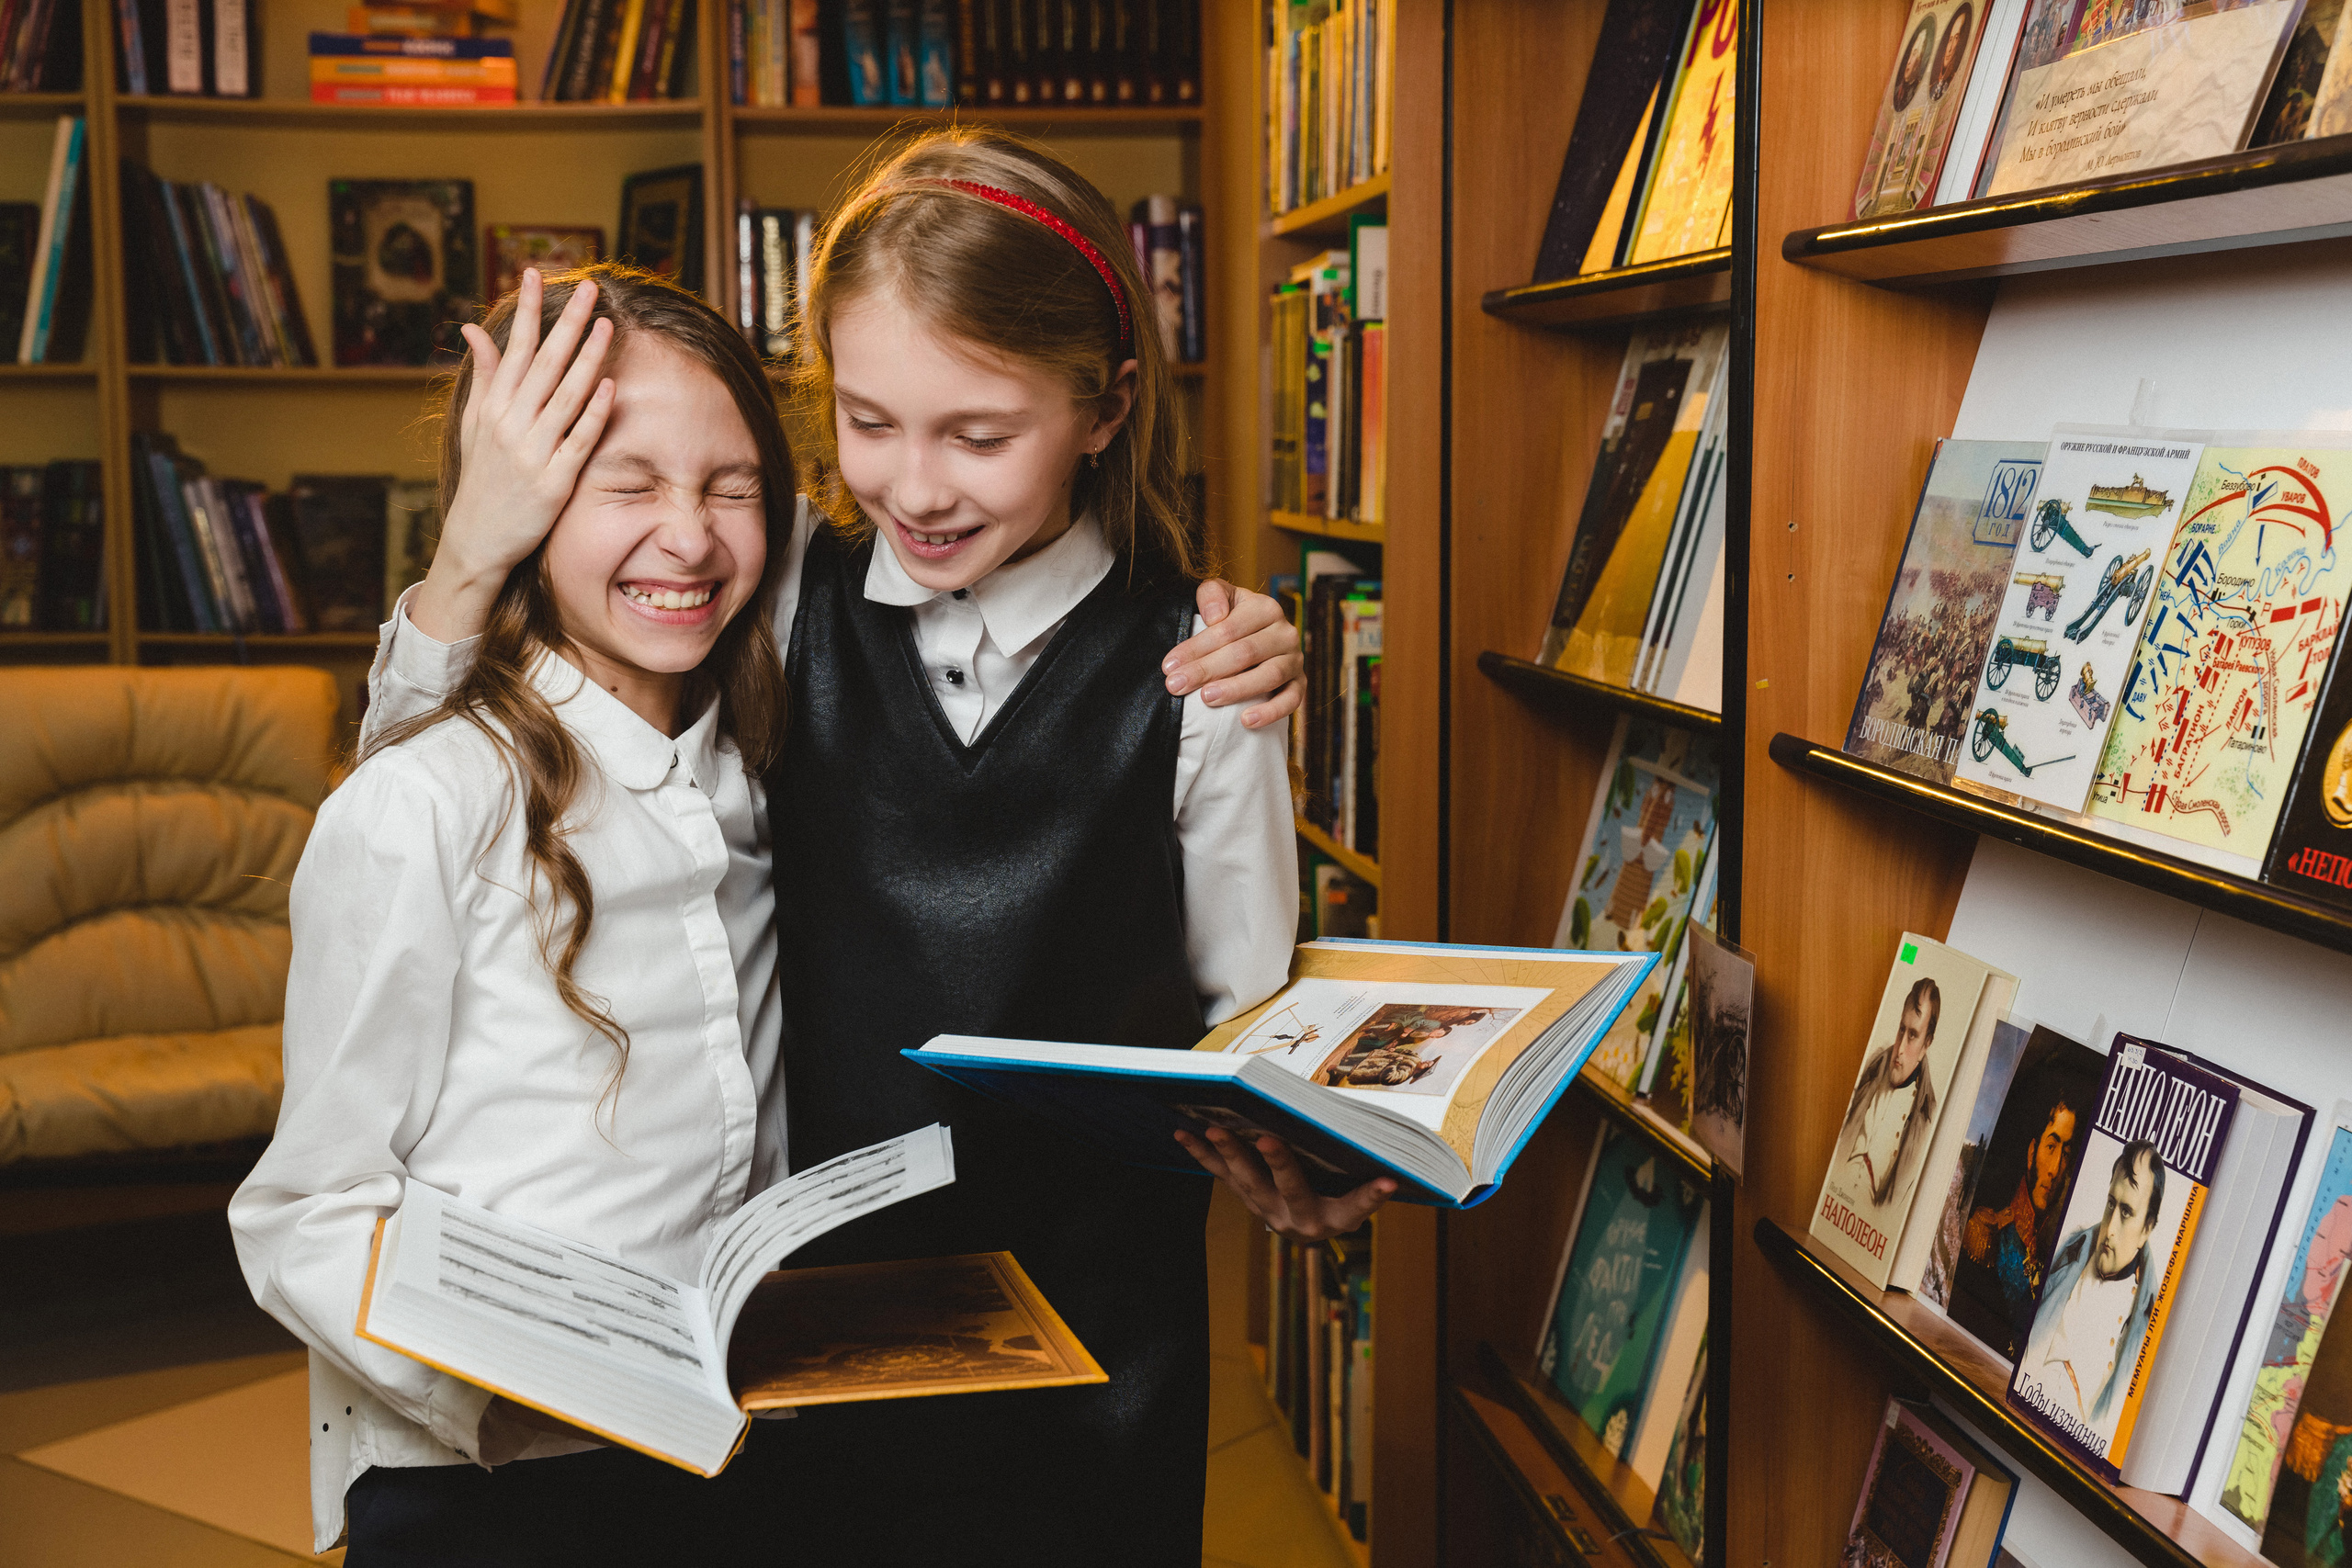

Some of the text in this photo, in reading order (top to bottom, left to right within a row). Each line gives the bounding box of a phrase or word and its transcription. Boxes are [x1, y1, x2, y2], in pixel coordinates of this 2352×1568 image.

[2049, 86, 2086, 112] умереть
[2086, 81, 2103, 96] мы
[2104, 67, 2146, 90] обещали,
[2027, 89, 2159, 137] И клятву верности сдержали
[2018, 145, 2036, 163] Мы
[2038, 148, 2044, 159] в
[2045, 125, 2102, 159] бородинский
[2060, 441, 2190, 459] ОРУЖИЕ РУССКОЙ И ФРАНЦУЗСКОЙ АРМИЙ
[2297, 457, 2320, 479] ПЛАТОВ
[1984, 467, 2037, 521] 1812
[2221, 479, 2256, 491] Беззубово
[2280, 491, 2307, 504] УВАРОВ
[1988, 523, 2011, 538] ГОД
[2191, 523, 2216, 535] БОГАРНЕ
[2217, 572, 2256, 588] Бородино
[2226, 617, 2246, 629] Горки
[2239, 636, 2272, 651] КУТУЗОВ
[2234, 660, 2266, 675] Раевского
[2132, 693, 2147, 703] ДАВУ
[2225, 688, 2248, 730] ЛАВРОВ
[1859, 716, 1944, 760] БОРОДИНСКАЯ
[2174, 705, 2205, 779] БАГРАТИОН
[2228, 737, 2267, 754] Татариново
[2095, 1052, 2227, 1179] НАПОЛЕОН
[1820, 1193, 1889, 1261] НАПОЛЕОН
[2127, 1185, 2199, 1398] МЕМУАРЫ ЛУИ-ЖОЗЕФА МАРШАНА
[2018, 1372, 2108, 1459] Годы изгнания
